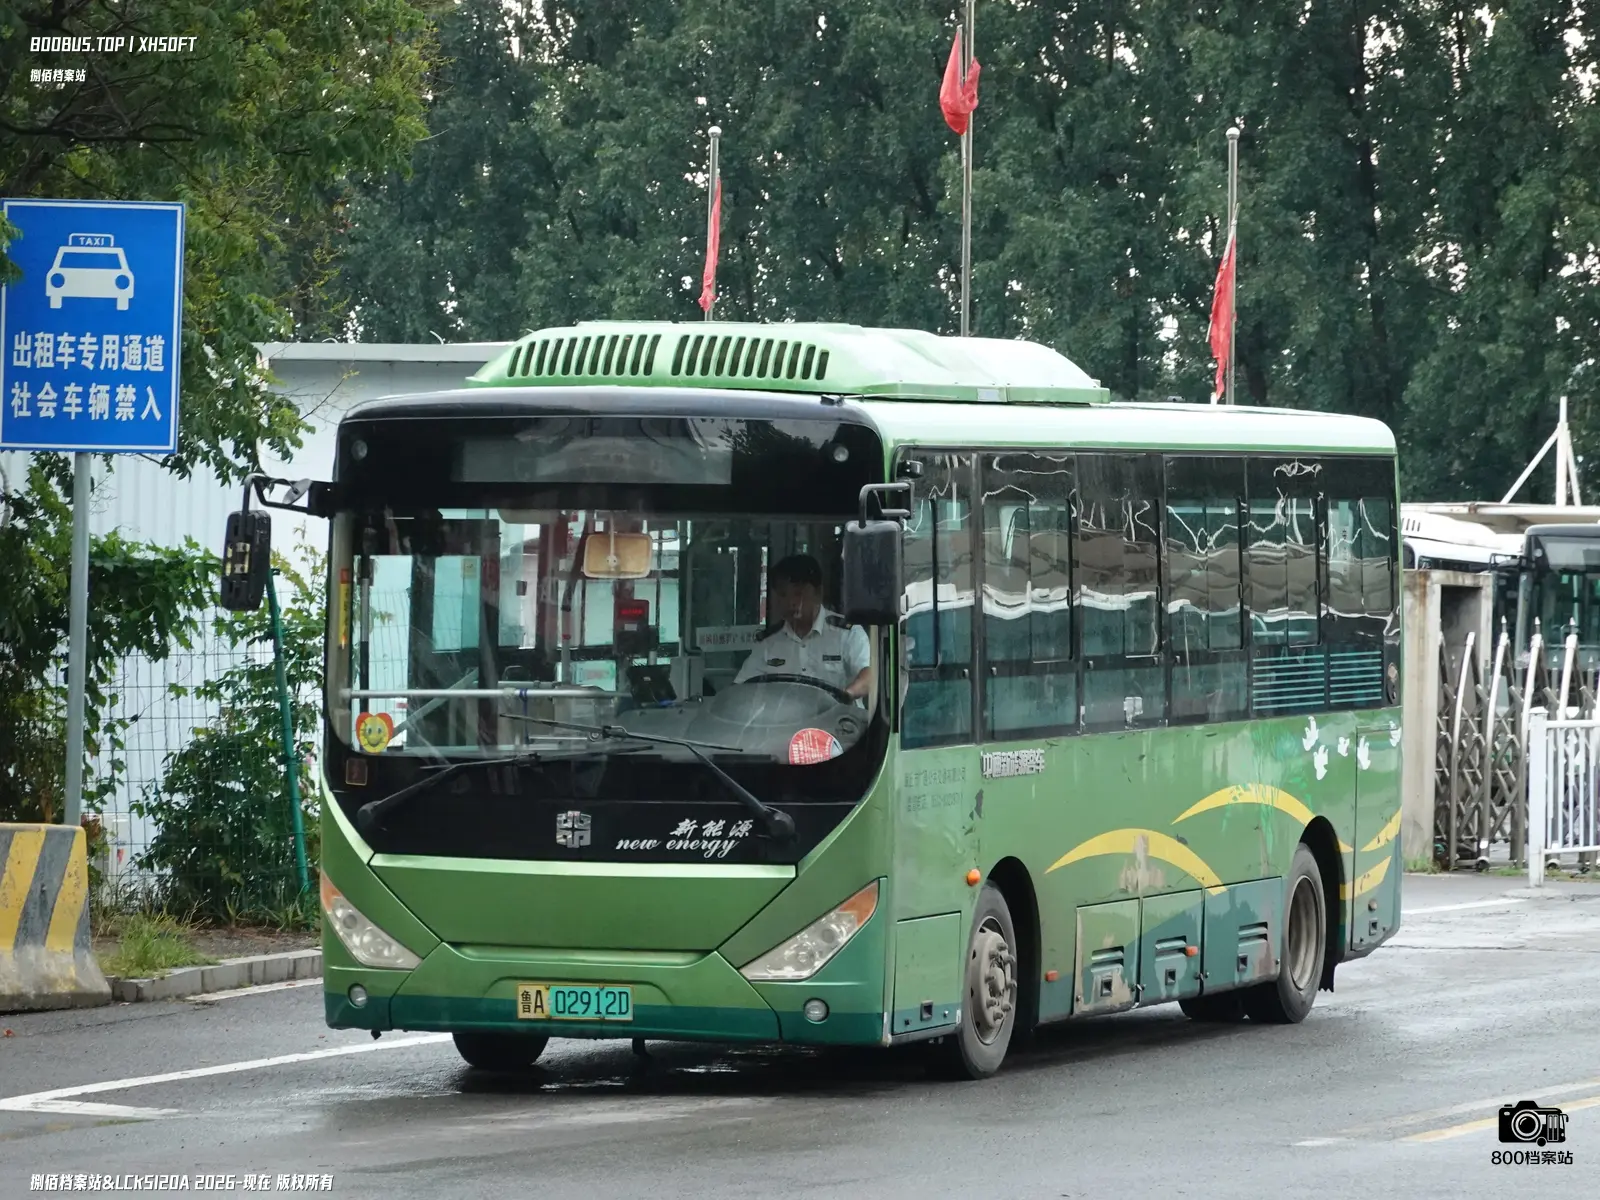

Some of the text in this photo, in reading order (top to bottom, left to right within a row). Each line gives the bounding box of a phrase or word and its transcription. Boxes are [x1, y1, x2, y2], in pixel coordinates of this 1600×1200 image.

[78, 236, 105, 247] TAXI
[12, 330, 165, 372] 出租车专用通道
[10, 381, 162, 422] 社会车辆禁入
[669, 818, 754, 839] 新能源
[615, 838, 740, 859] new energy
[520, 989, 630, 1015] 鲁A 02912D
